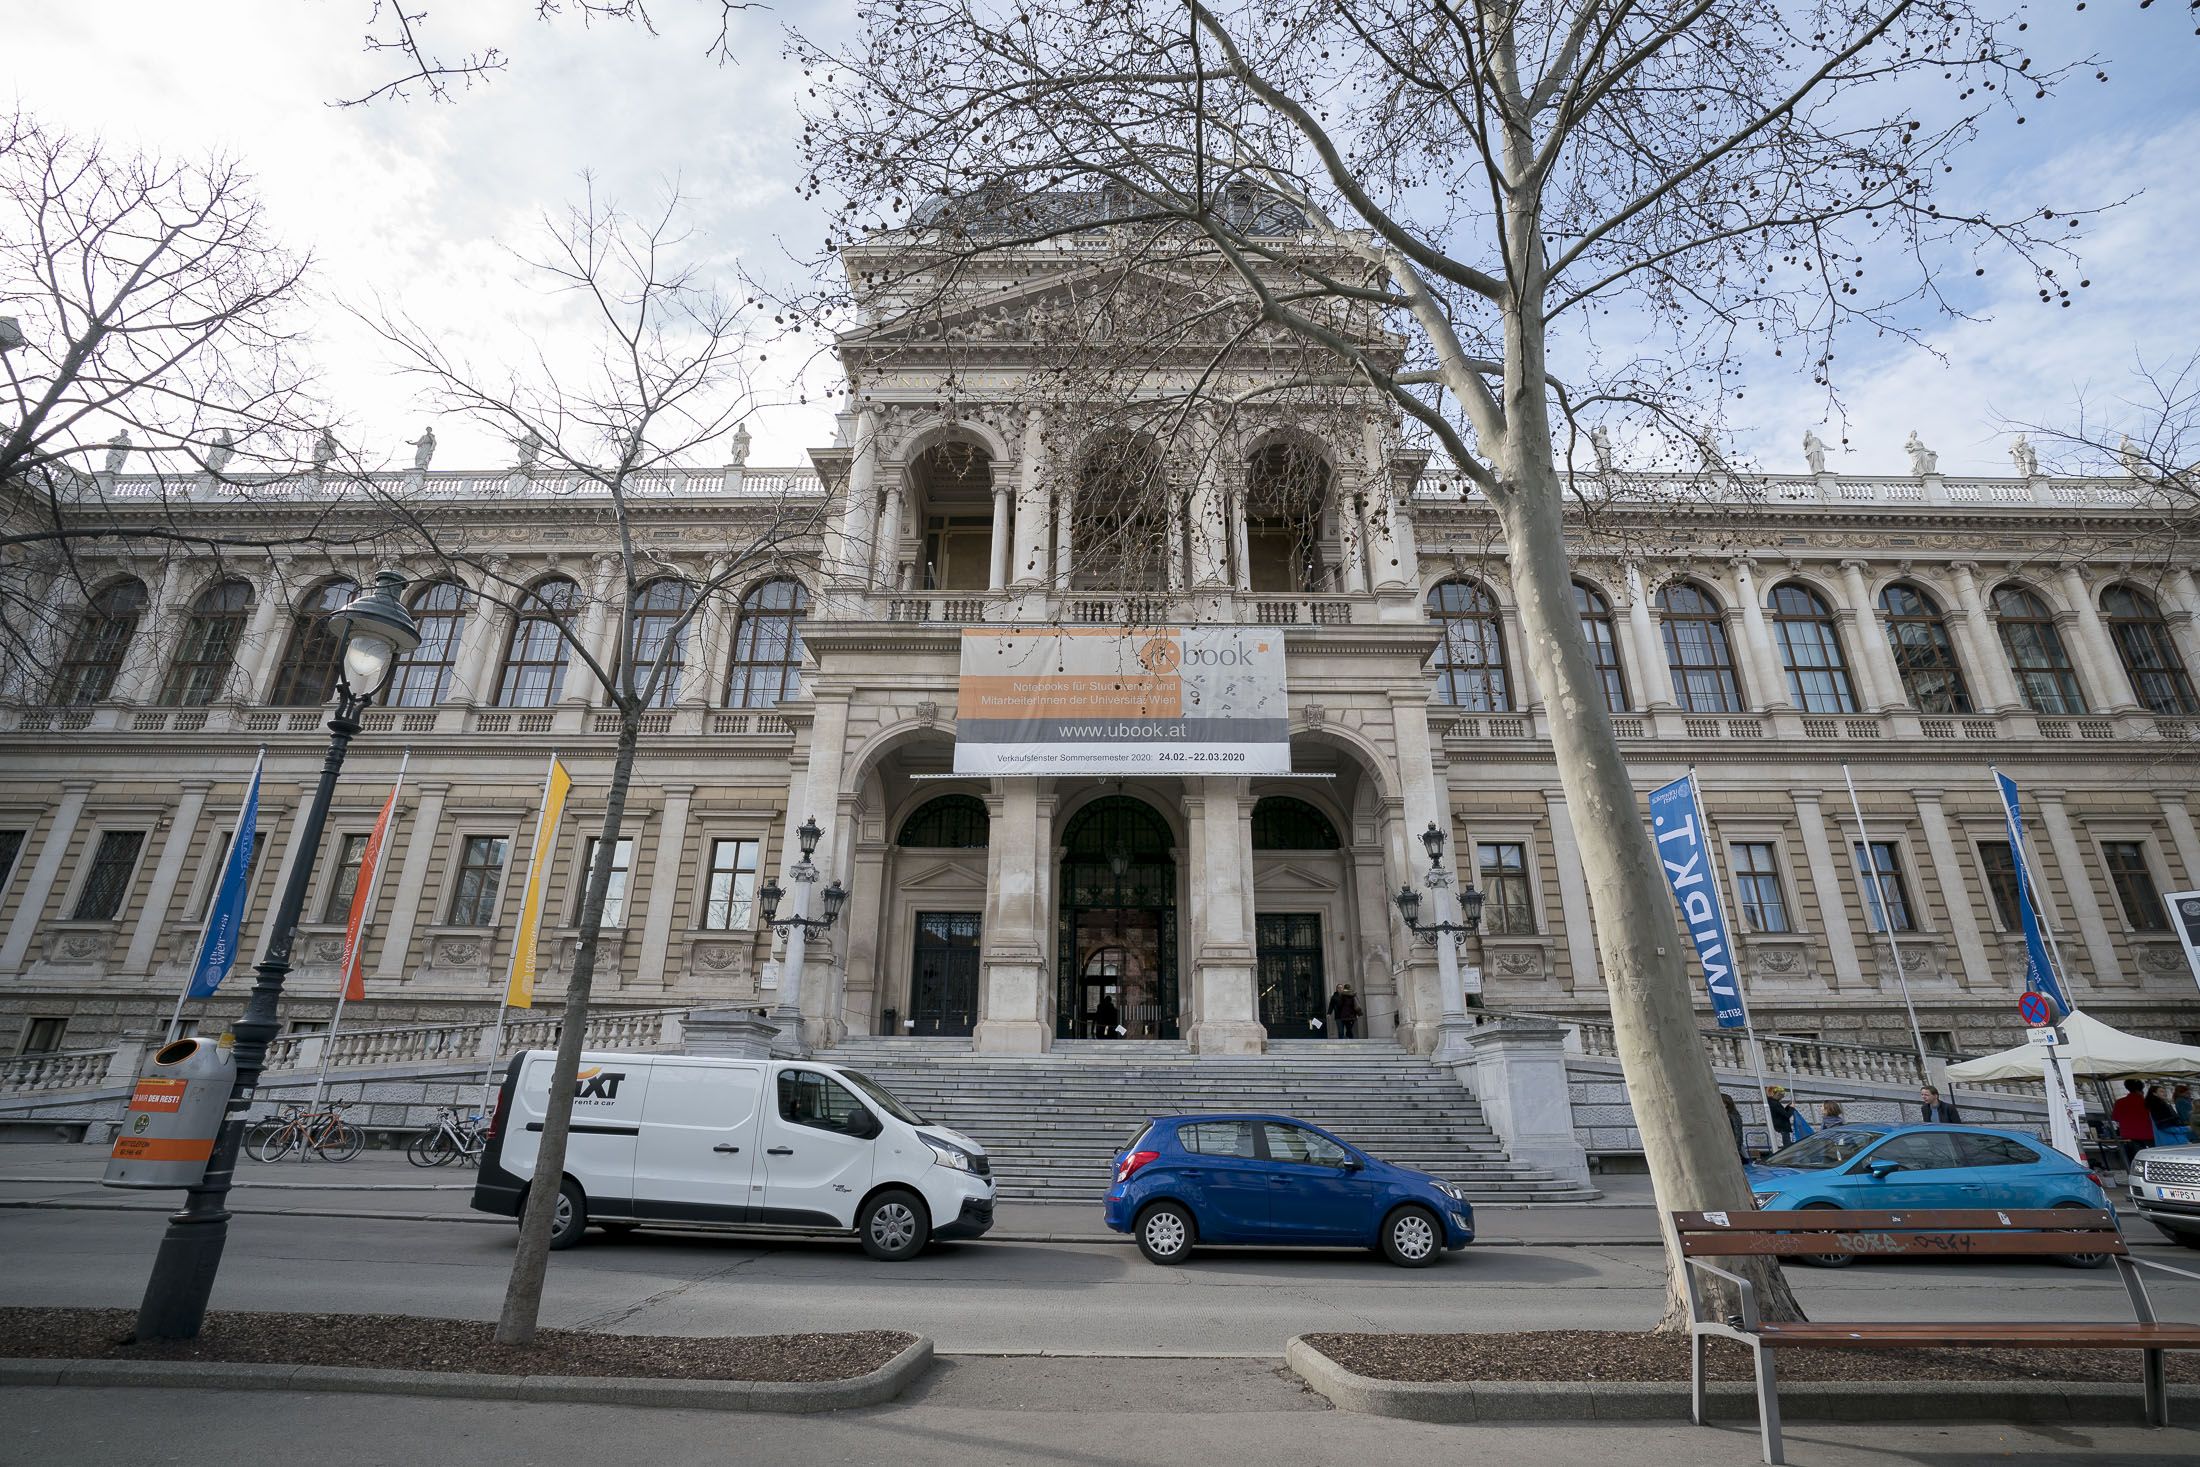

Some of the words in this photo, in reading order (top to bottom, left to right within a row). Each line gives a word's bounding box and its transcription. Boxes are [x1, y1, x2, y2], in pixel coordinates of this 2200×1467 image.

[1013, 682, 1069, 692] Notebooks
[1072, 681, 1085, 691] für
[1157, 682, 1176, 691] und
[981, 695, 1068, 705] MitarbeiterInnen
[1070, 695, 1087, 705] der
[1150, 695, 1176, 705] Wien
[1059, 722, 1187, 738] www.ubook.at
[997, 754, 1058, 762] Verkaufsfenster
[1060, 754, 1129, 762] Sommersemester
[548, 1073, 626, 1099] IXT
[148, 1094, 160, 1102] DEN
[160, 1095, 180, 1104] REST!
